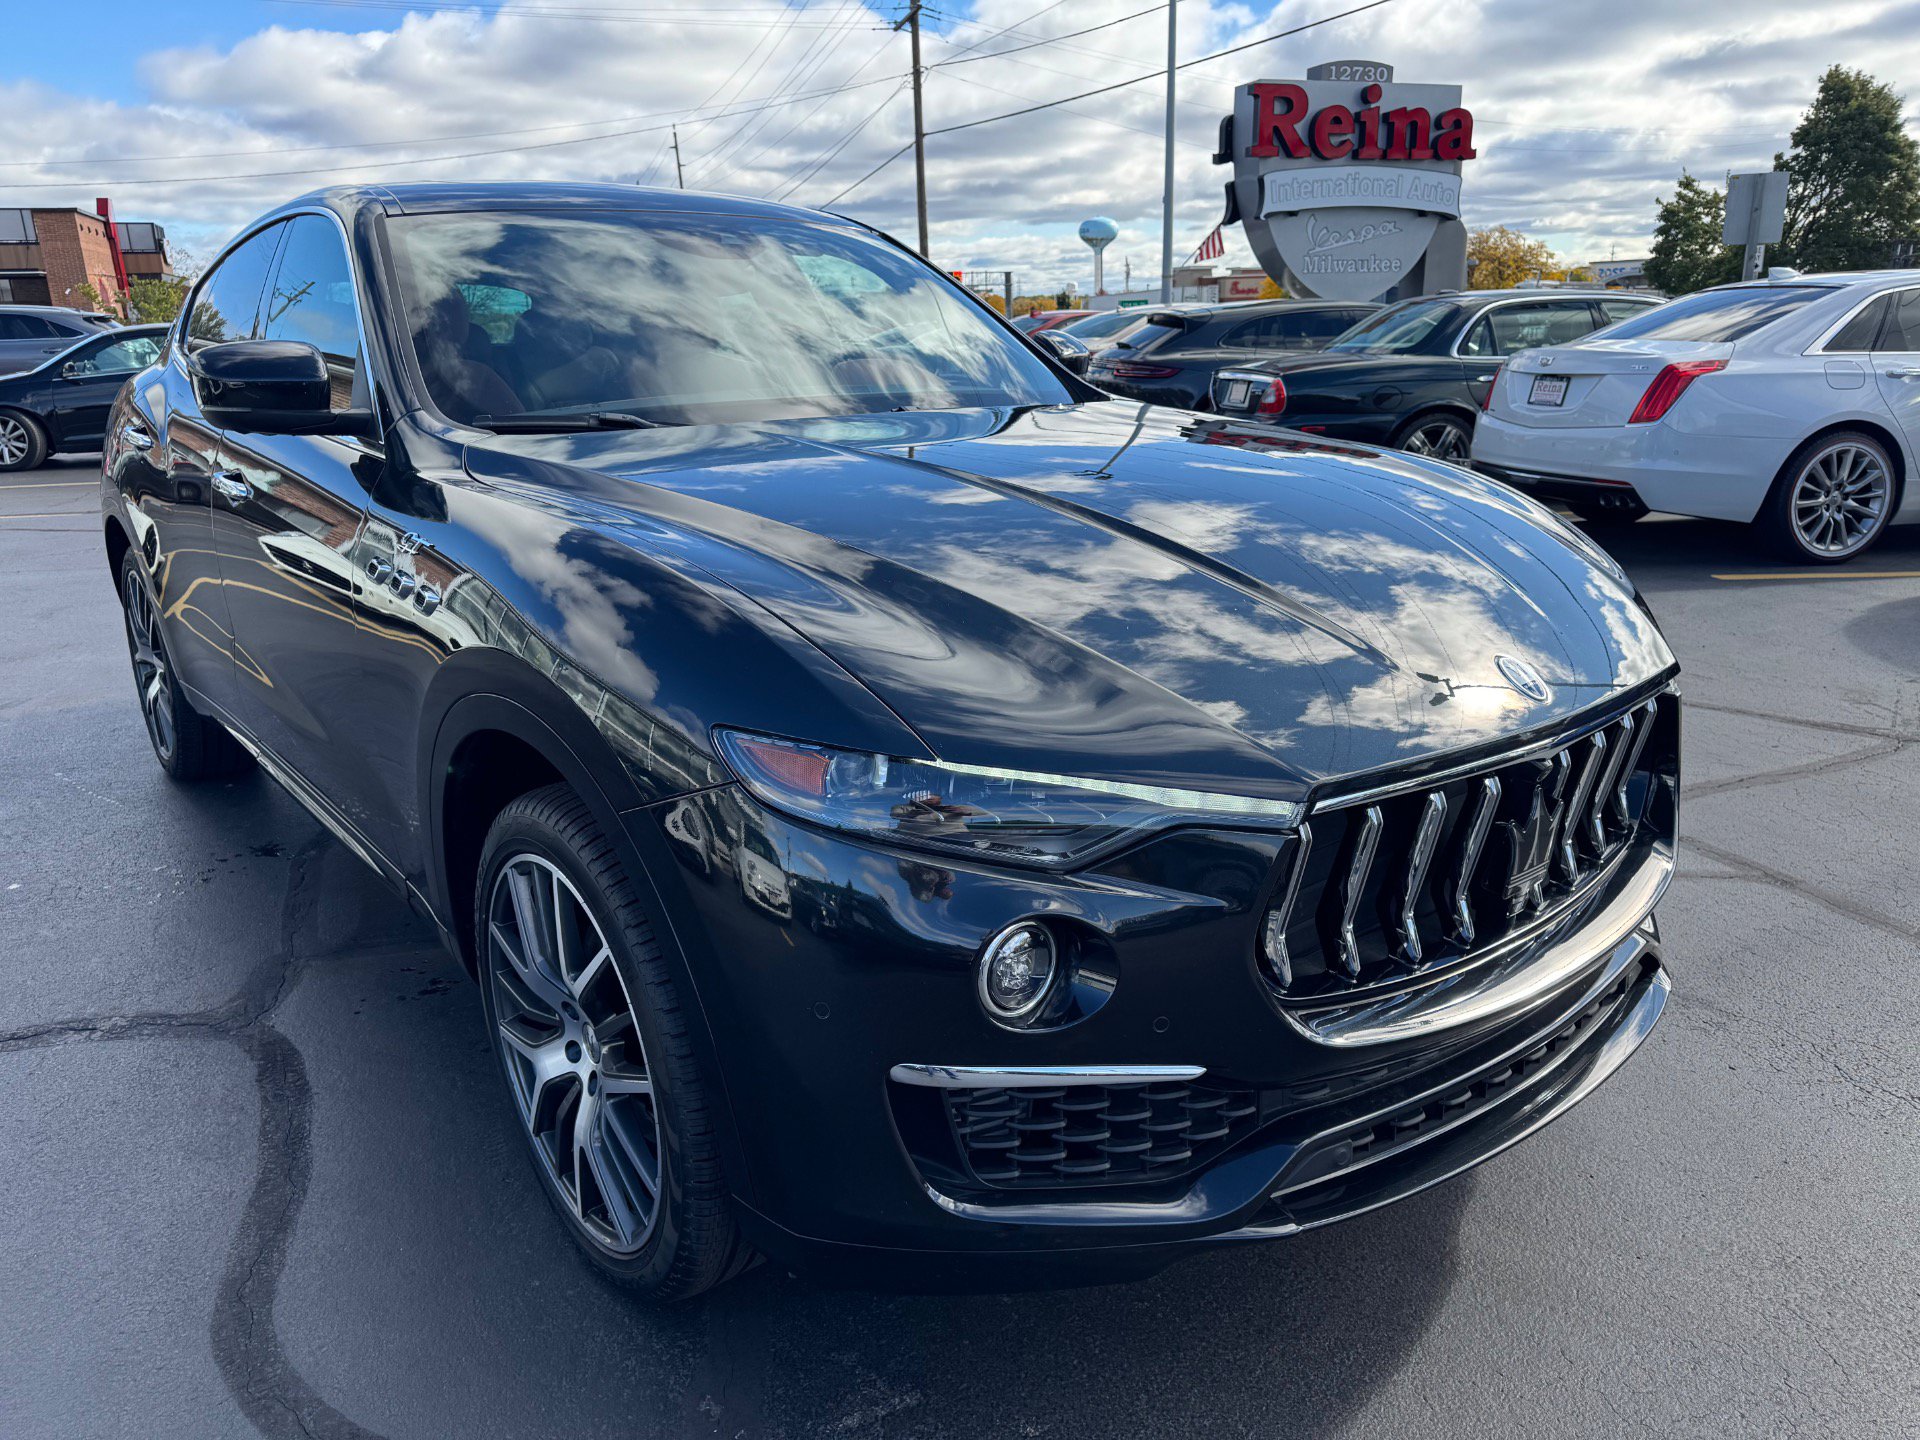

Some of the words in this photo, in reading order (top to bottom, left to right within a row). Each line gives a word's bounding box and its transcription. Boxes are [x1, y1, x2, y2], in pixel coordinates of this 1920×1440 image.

[1329, 65, 1388, 82] 12730
[1247, 83, 1477, 161] Reina
[1270, 172, 1402, 204] International
[1407, 176, 1456, 207] Auto
[1305, 213, 1403, 254] Vespa
[1302, 255, 1402, 275] Milwaukee
[1535, 381, 1562, 393] Reina
